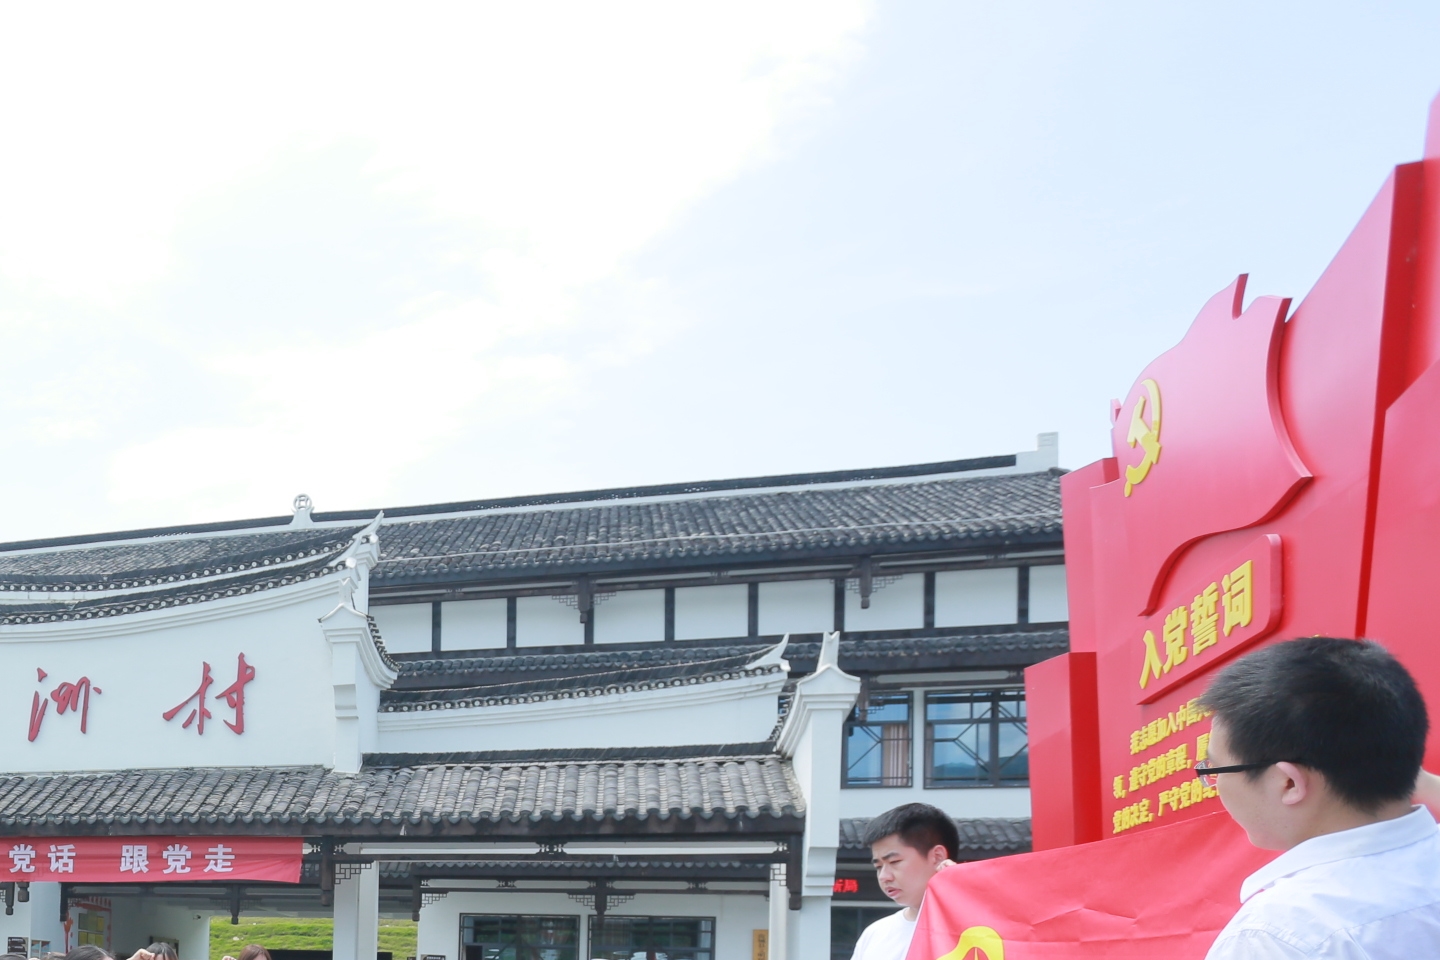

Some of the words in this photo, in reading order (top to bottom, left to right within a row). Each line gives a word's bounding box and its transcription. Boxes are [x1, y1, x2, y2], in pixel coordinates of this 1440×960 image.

[1138, 559, 1253, 689] 入党誓词
[1129, 696, 1213, 755] 我志愿加入中国
[120, 843, 236, 875] 跟党走
